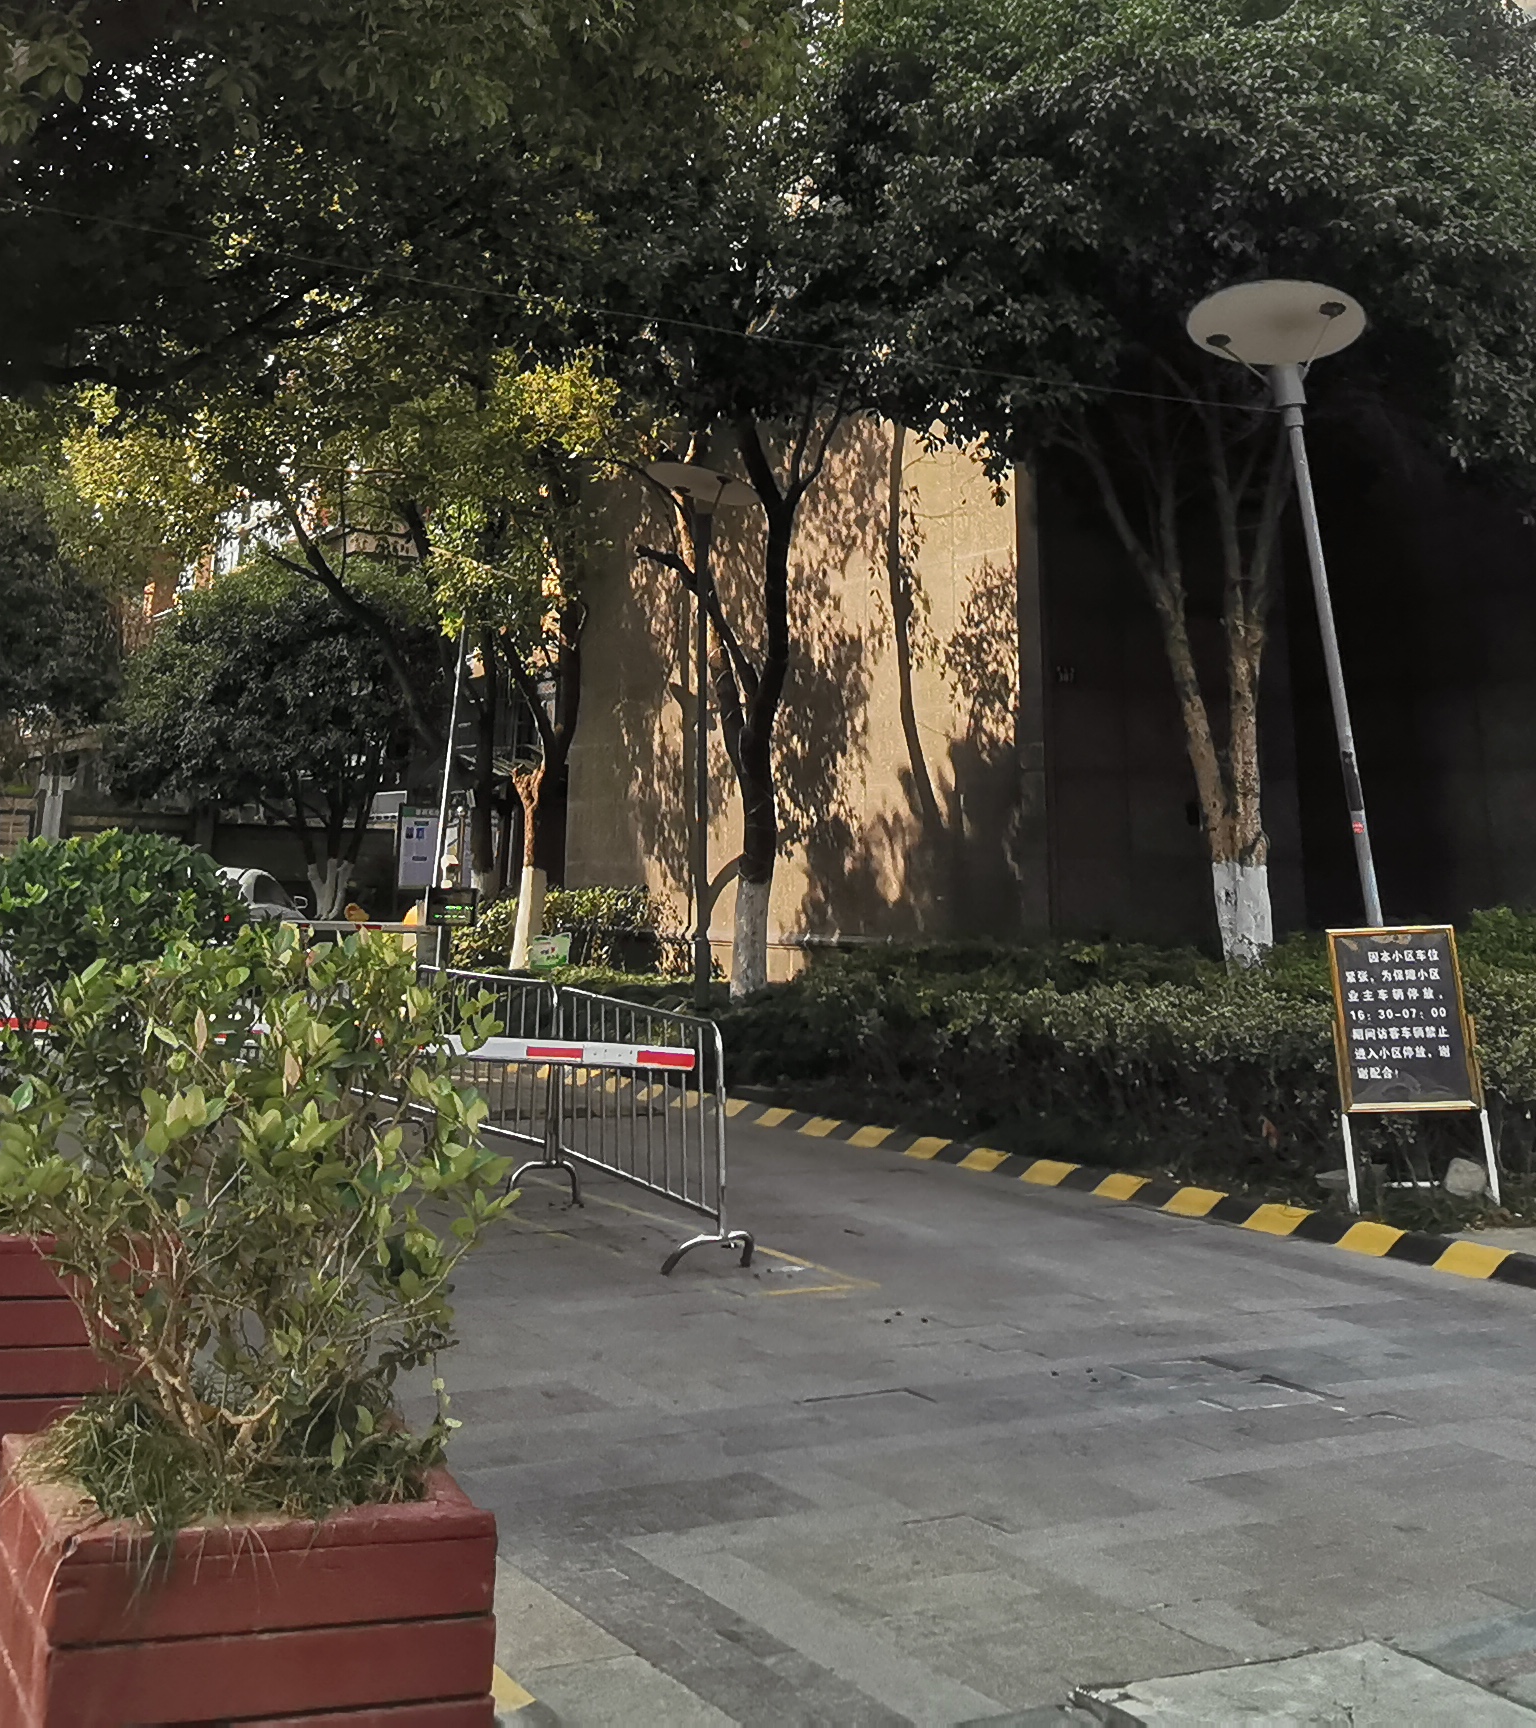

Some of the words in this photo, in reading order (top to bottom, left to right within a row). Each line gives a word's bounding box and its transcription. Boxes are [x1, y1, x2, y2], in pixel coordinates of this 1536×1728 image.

[1367, 948, 1440, 964] 因本小区车位
